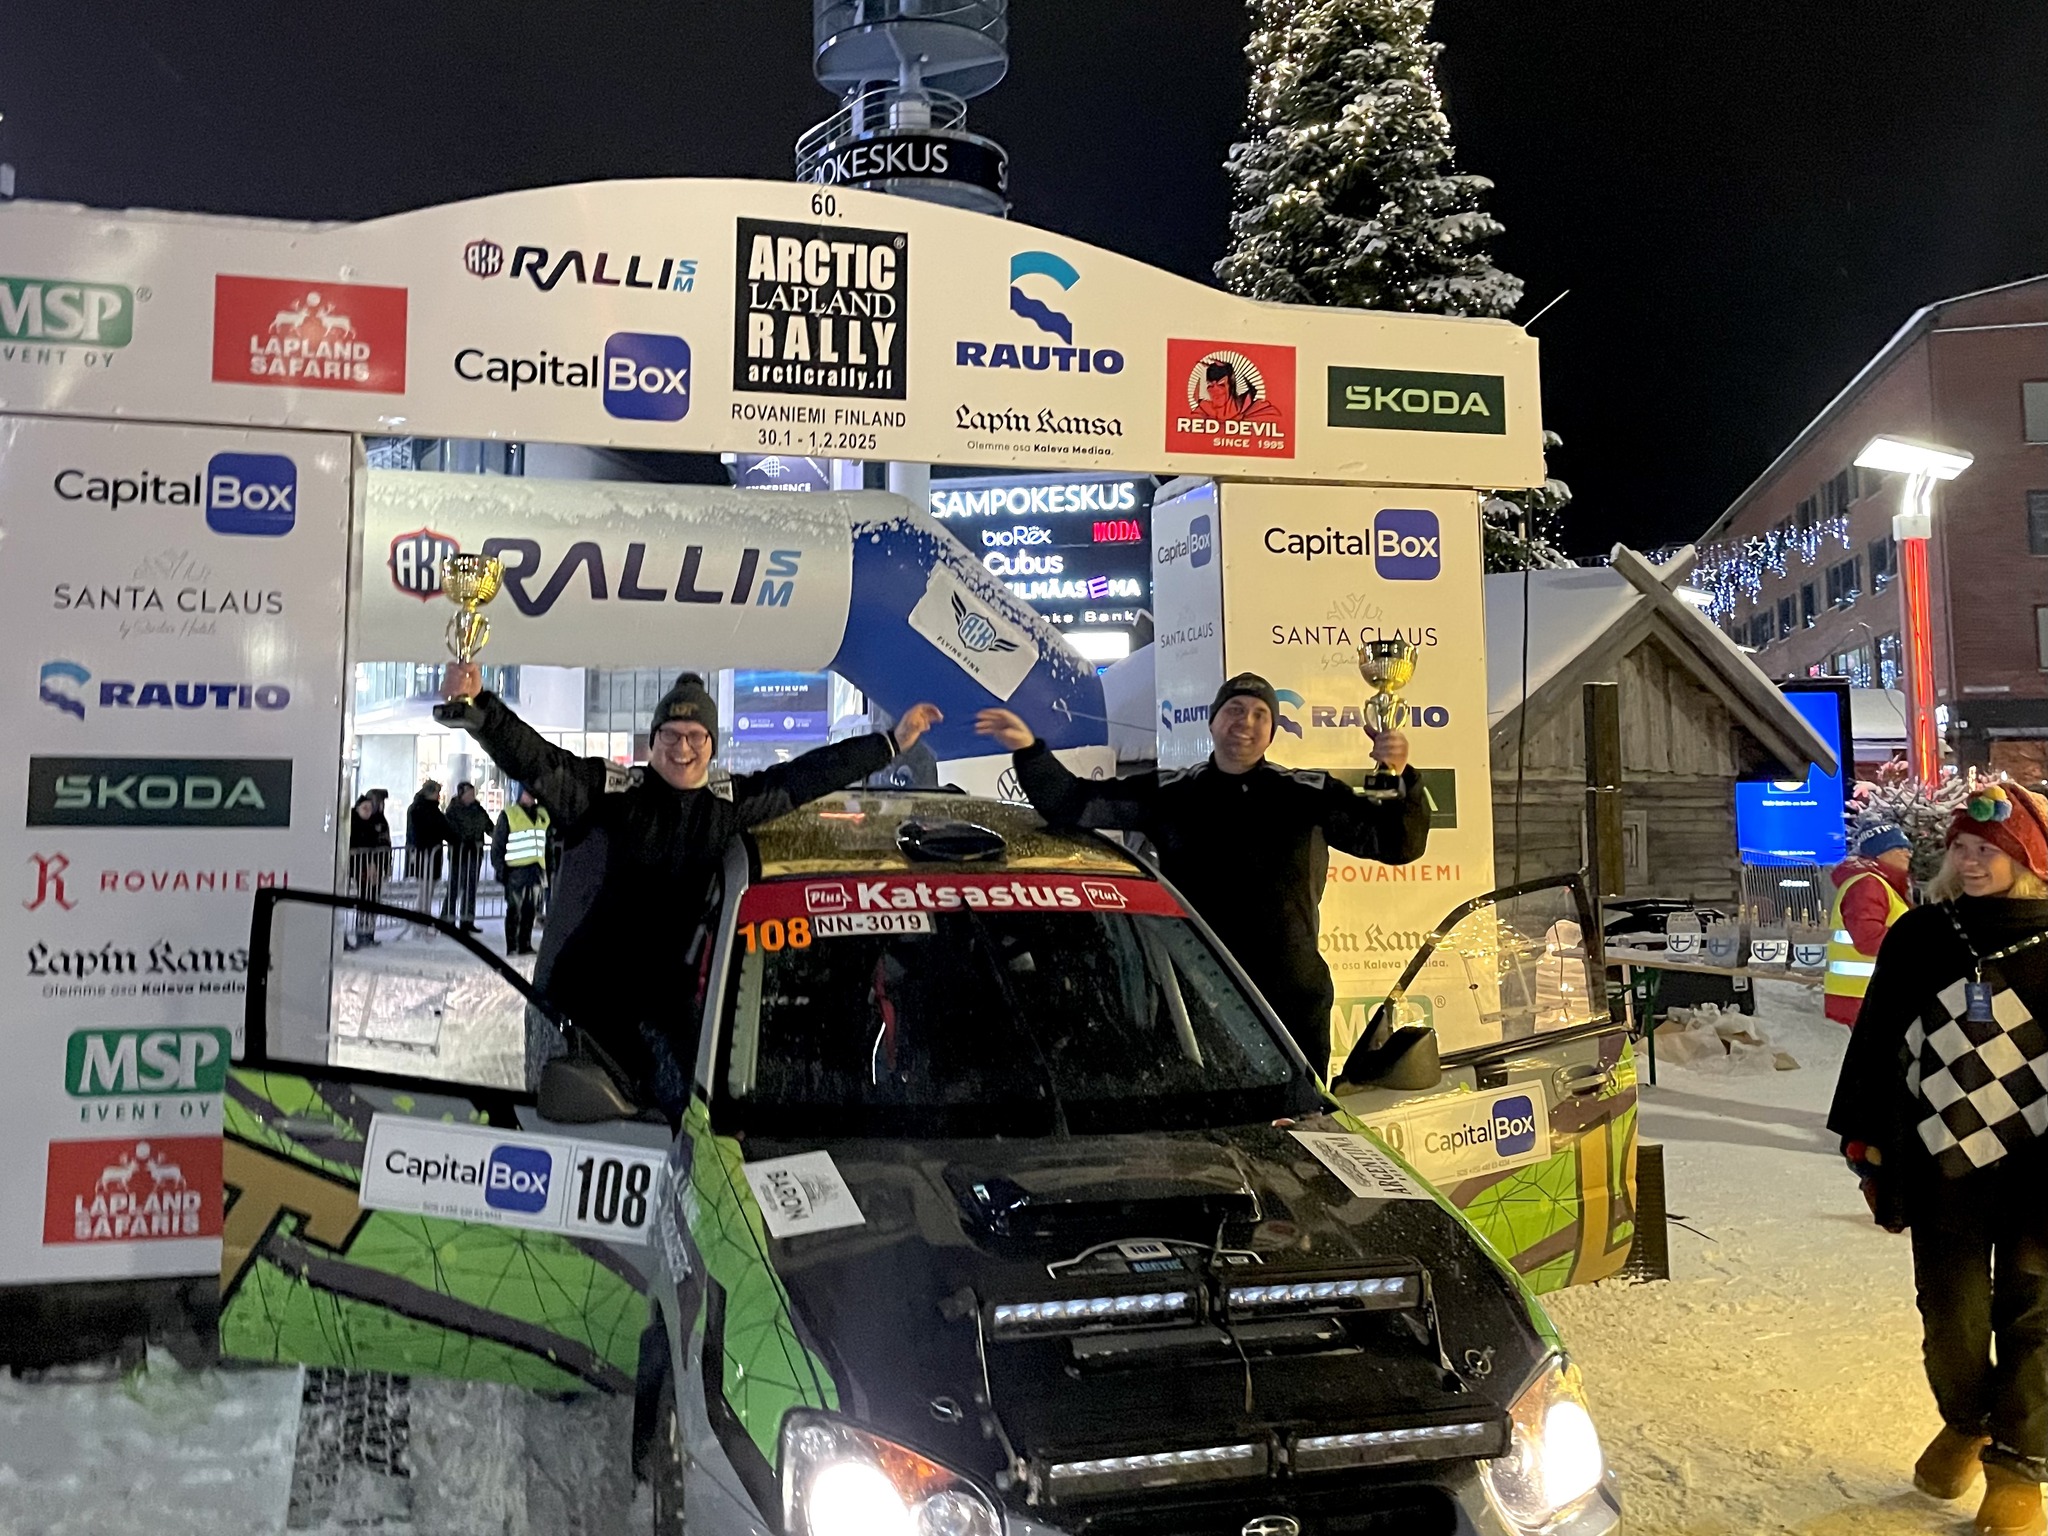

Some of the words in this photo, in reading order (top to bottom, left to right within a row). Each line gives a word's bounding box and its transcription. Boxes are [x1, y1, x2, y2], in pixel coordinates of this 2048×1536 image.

[811, 193, 843, 218] 60.
[508, 246, 673, 292] RALLI
[747, 234, 897, 290] ARCTIC
[748, 283, 897, 319] LAPLAND
[249, 335, 371, 362] LAPLAND
[747, 312, 897, 366] RALLY
[4, 344, 66, 366] VENT
[83, 350, 115, 369] OY
[249, 356, 370, 383] SAFARIS
[955, 340, 1125, 375] RAUTIO
[731, 403, 827, 425] ROVANIEMI
[834, 409, 907, 428] FINLAND
[1035, 407, 1124, 437] Kansa
[1176, 416, 1221, 434] RED
[1225, 419, 1285, 438] DEVIL
[757, 429, 792, 448] 30.1
[808, 431, 877, 451] 1.2.2025
[967, 440, 1010, 452] Olemme
[1033, 444, 1069, 454] Kaleva
[1213, 437, 1251, 448] SINCE
[1257, 438, 1285, 451] 1995
[931, 482, 1136, 518] SAMPOKESKUS
[1092, 519, 1142, 543] MODA
[983, 548, 1064, 576] Cubus
[53, 582, 165, 613] SANTA
[177, 587, 284, 616] CLAUS
[1160, 629, 1186, 649] SANTA
[1187, 622, 1214, 643] CLAUS
[1271, 625, 1352, 646] SANTA
[99, 681, 291, 711] RAUTIO
[1174, 704, 1209, 725] RAUTI
[1311, 705, 1450, 728] RAIO
[99, 869, 289, 893] ROVANIEMI
[808, 888, 842, 907] Plus
[857, 880, 1081, 911] Katsastus
[1089, 887, 1119, 905] Plus
[737, 916, 812, 953] 108
[817, 913, 923, 934] NN-3019
[1363, 922, 1432, 953] Kans
[145, 938, 250, 975] Kans
[1363, 960, 1401, 971] Kaleva
[77, 1031, 220, 1093] MSP
[80, 1104, 162, 1123] EVENT
[179, 1101, 211, 1119] OY
[74, 1189, 201, 1216] LAPLAND
[576, 1156, 652, 1229] 108
